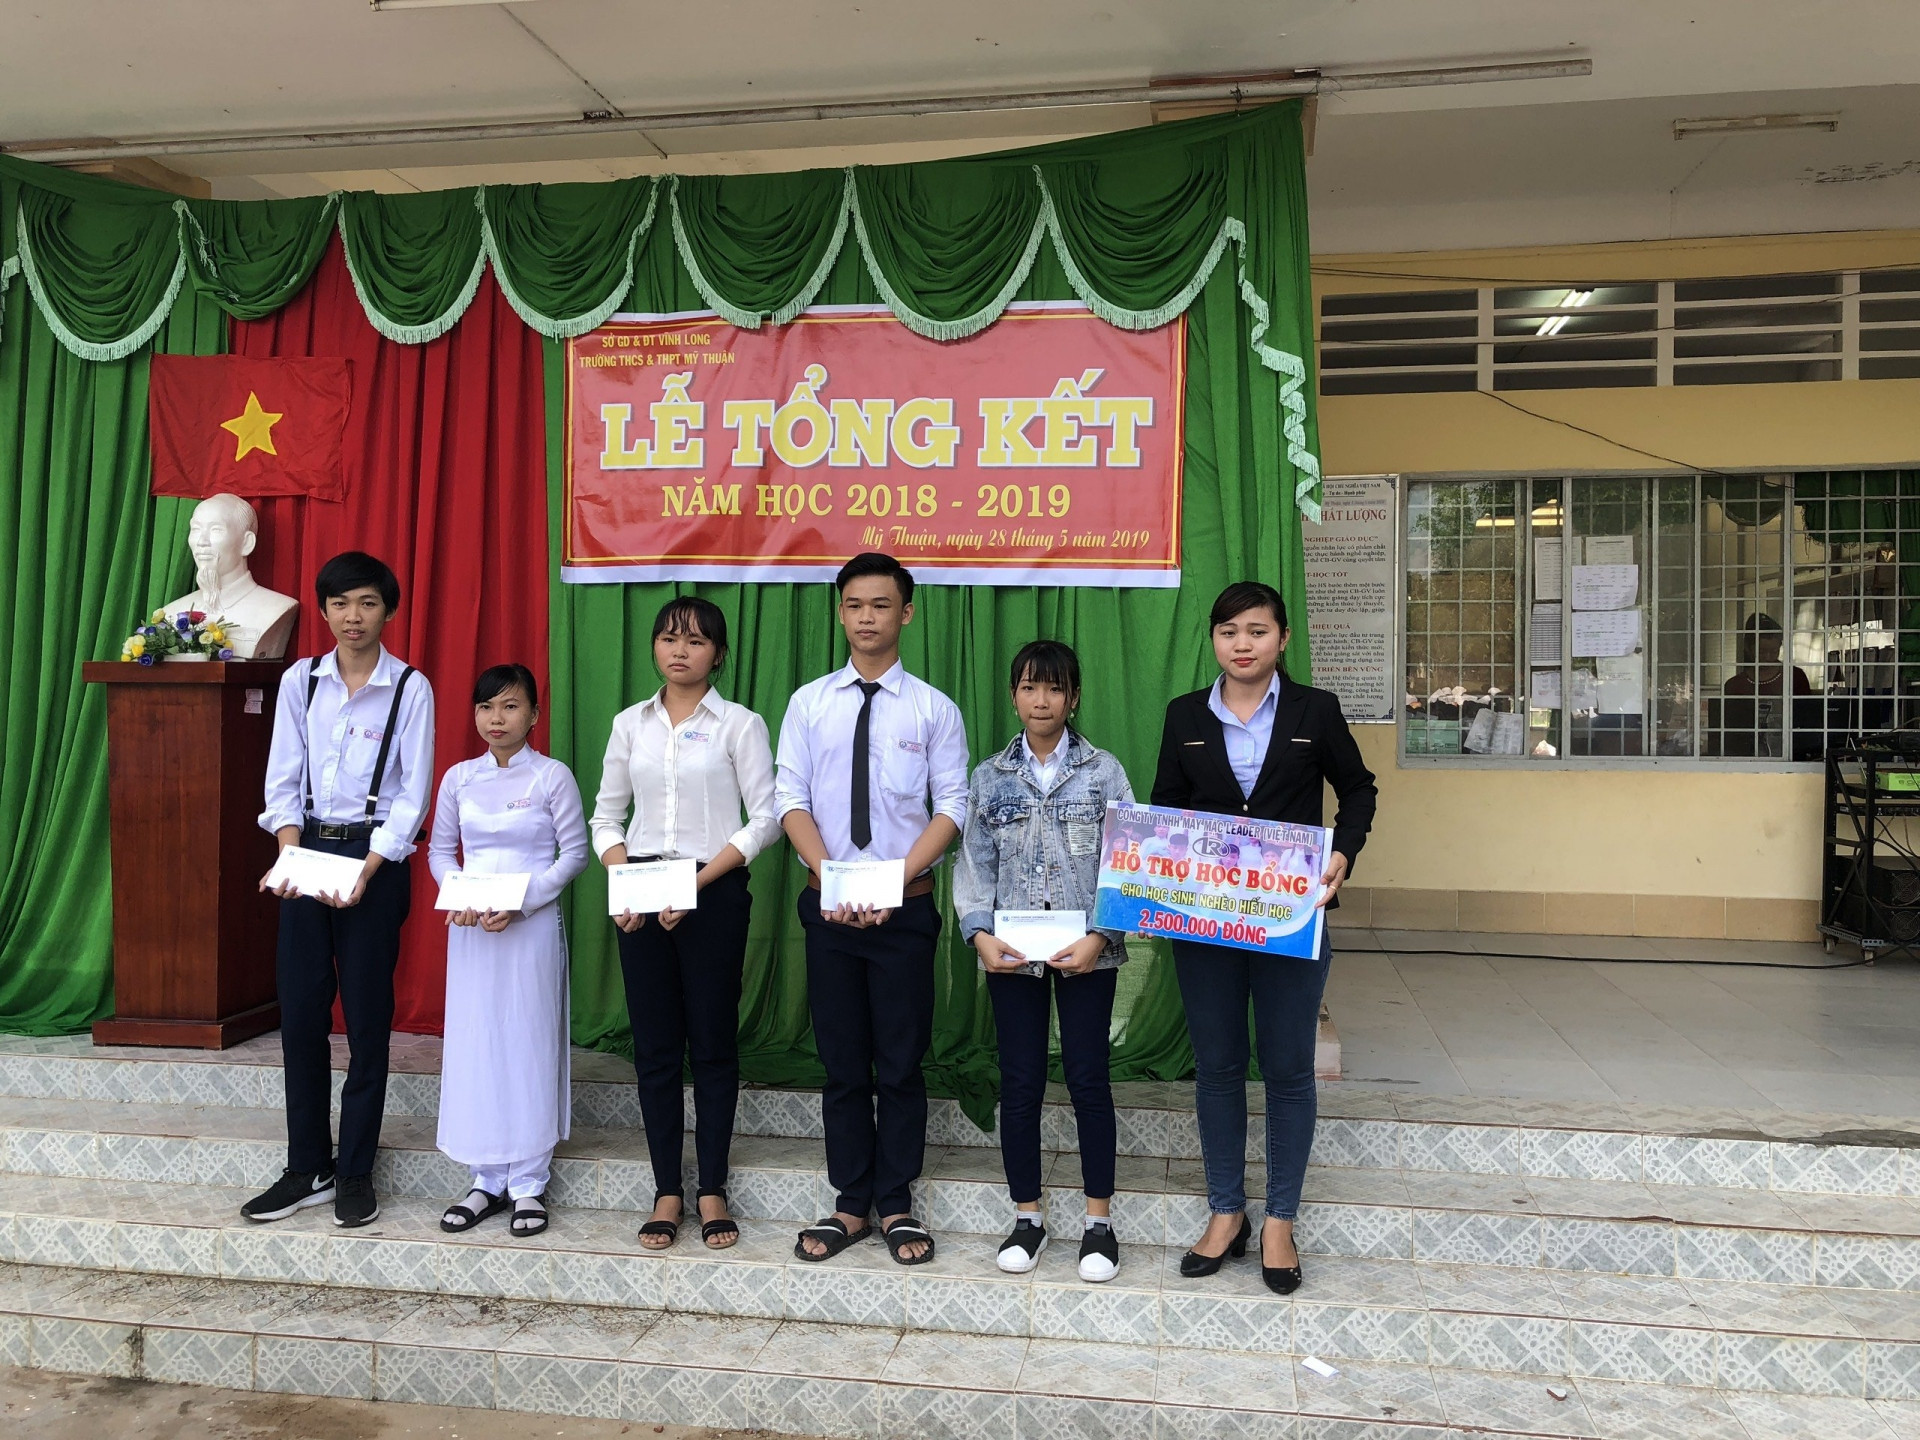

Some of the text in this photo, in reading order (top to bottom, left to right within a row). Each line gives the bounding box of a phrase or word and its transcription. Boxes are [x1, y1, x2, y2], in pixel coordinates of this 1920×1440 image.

[602, 332, 710, 347] SỞ GD & ĐT VĨNH LONG
[580, 350, 734, 368] TRƯỜNG THCS & THPT MỸ THUẬN
[600, 363, 1154, 470] LỄ TỔNG KẾT
[661, 476, 743, 516] NĂM
[756, 483, 833, 523] HỌC
[847, 483, 937, 517] 2018
[977, 484, 1072, 517] 2019
[1322, 508, 1343, 521] HẤT
[1347, 509, 1386, 522] LƯỢNG
[858, 525, 1150, 551] Mỹ Thuận, ngày 28 tháng 5 năm 2019
[1118, 808, 1142, 822] CÔNG
[1143, 812, 1155, 824] TY
[1157, 813, 1180, 827] TNHH
[1226, 822, 1260, 838] LEADER
[1263, 825, 1288, 842] (VIỆT
[1289, 829, 1313, 846] NAM)
[1111, 842, 1309, 896] HỖ TRỢ HỌC BỔNG
[1122, 882, 1292, 923] CHO HỌC SINH NGHÈO HIẾU HỌC
[1139, 909, 1267, 946] 2.500.000 ĐỒNG
